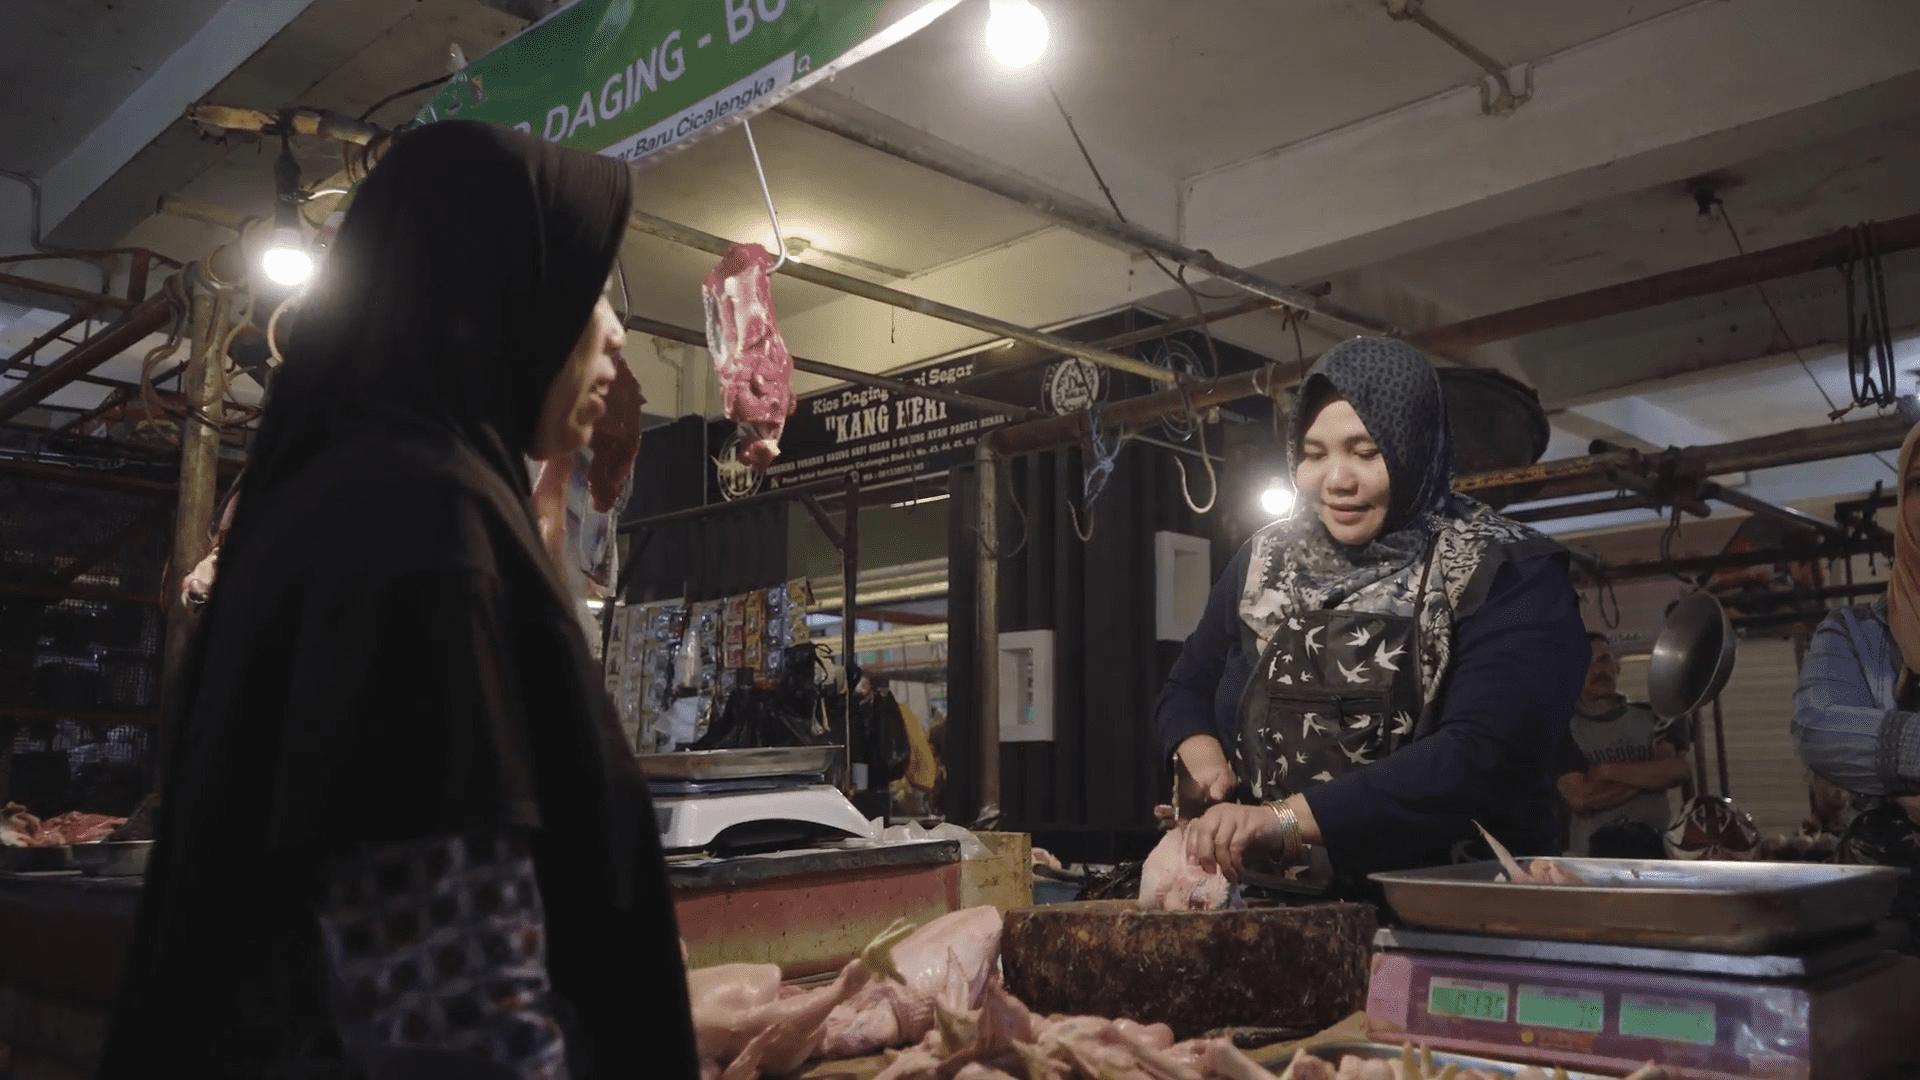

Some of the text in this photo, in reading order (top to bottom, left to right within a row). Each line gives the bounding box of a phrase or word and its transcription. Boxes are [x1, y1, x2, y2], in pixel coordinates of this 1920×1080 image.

[544, 31, 686, 142] DAGING
[634, 128, 674, 158] Baru
[676, 77, 776, 138] Cicalengka
[812, 397, 840, 415] Kios
[841, 386, 889, 407] Daging
[928, 363, 974, 386] Segar
[926, 427, 948, 440] AYAM
